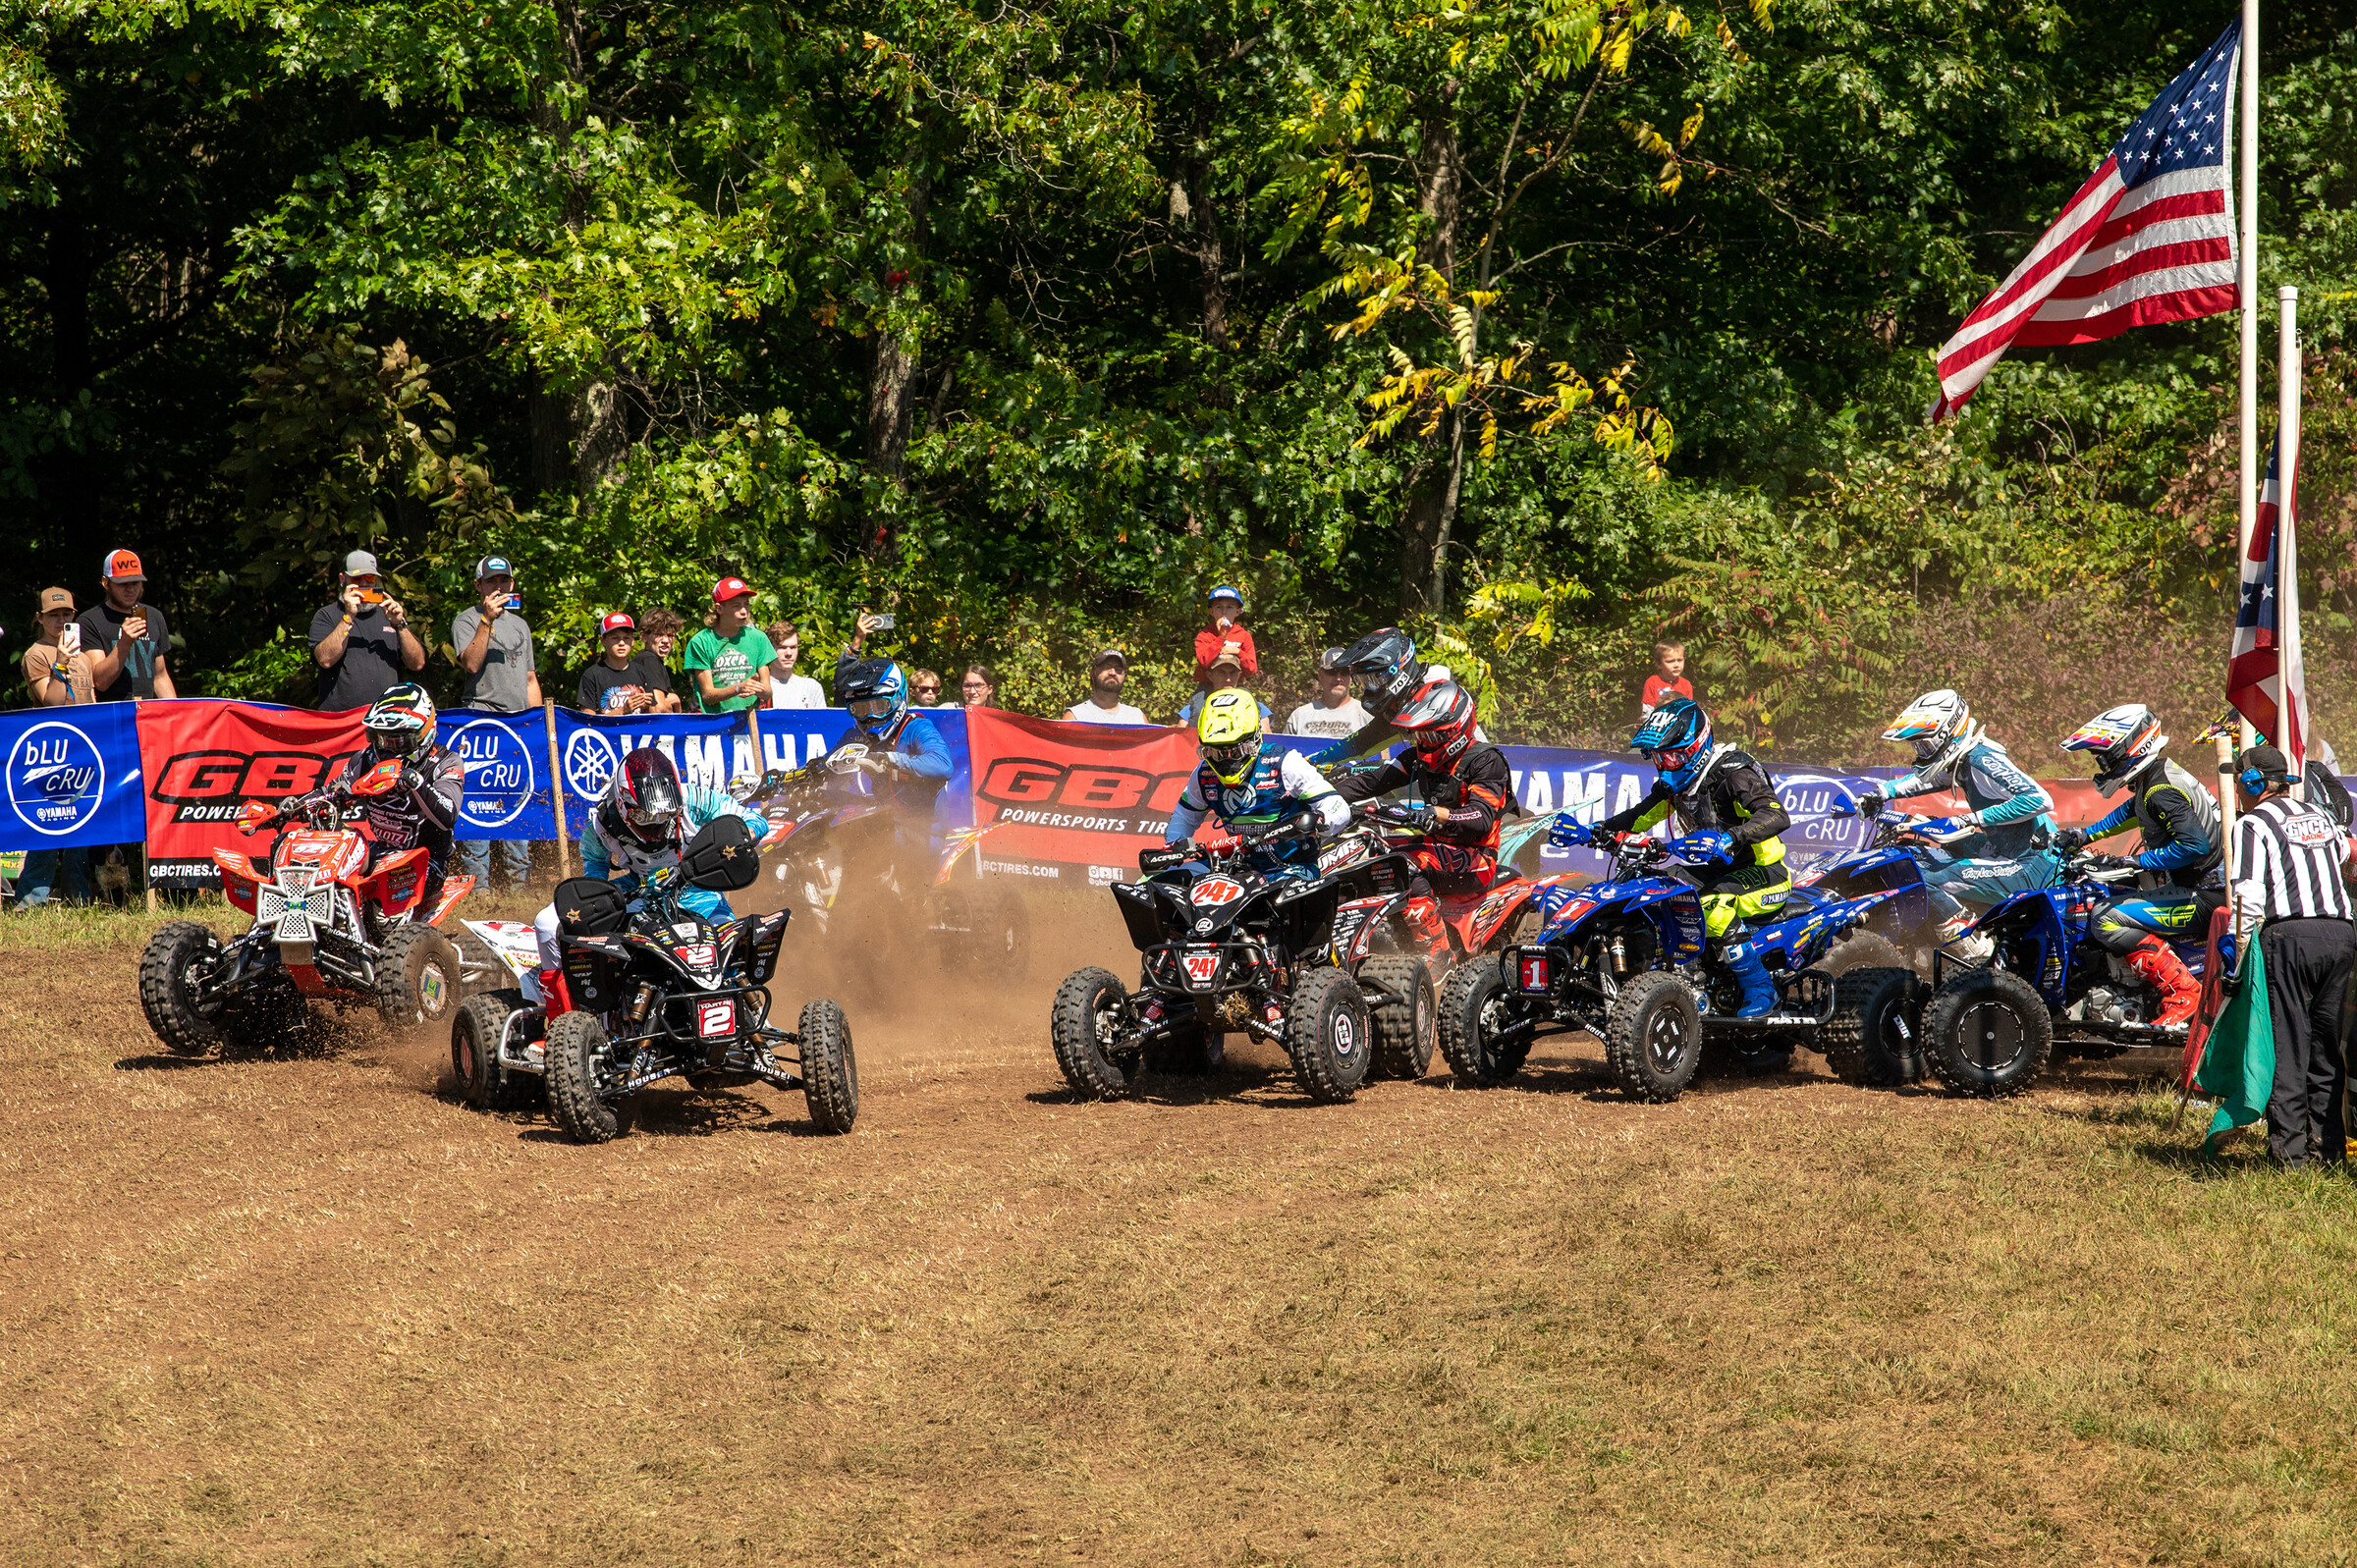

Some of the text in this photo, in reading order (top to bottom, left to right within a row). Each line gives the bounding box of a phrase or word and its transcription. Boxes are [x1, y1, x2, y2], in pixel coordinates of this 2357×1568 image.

[117, 560, 138, 569] WC
[1391, 674, 1408, 693] 703
[46, 806, 78, 818] YAMAHA
[1878, 813, 1903, 823] ENTHAL
[1001, 807, 1169, 835] POWERSPORTS TIR
[373, 827, 405, 842] KLOTZ
[2286, 820, 2331, 838] GNCC
[2302, 833, 2326, 841] RACING
[149, 864, 222, 878] GBCTIRES.C
[978, 860, 1060, 879] BCTIRES.COM
[1192, 881, 1240, 904] 241
[1767, 890, 1789, 903] YAMAHA
[2054, 892, 2079, 901] YAMAHA
[512, 951, 540, 960] MAXX
[1188, 957, 1217, 978] 241
[1529, 960, 1542, 988] 1
[703, 1005, 732, 1035] 2
